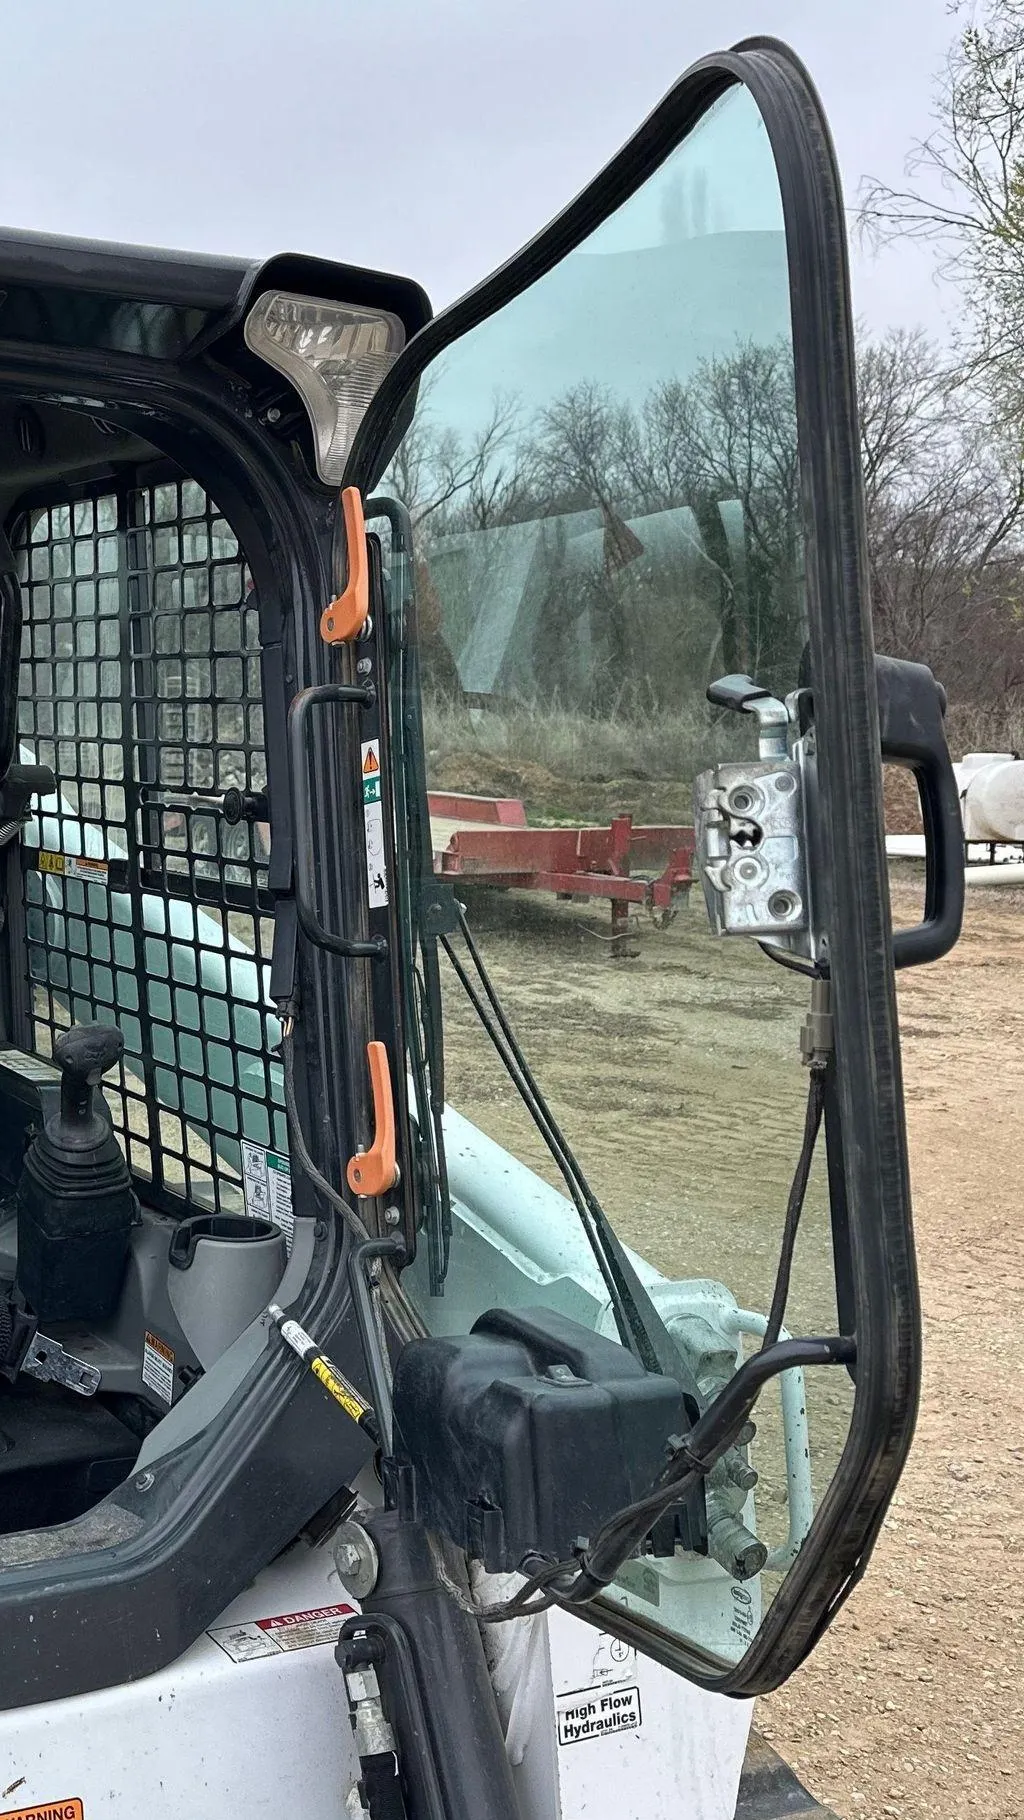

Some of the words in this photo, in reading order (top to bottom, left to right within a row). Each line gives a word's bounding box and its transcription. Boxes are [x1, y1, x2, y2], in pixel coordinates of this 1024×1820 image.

[283, 1606, 343, 1624] DANGER
[600, 1694, 633, 1712] Flow
[563, 1711, 637, 1739] Hydraulics
